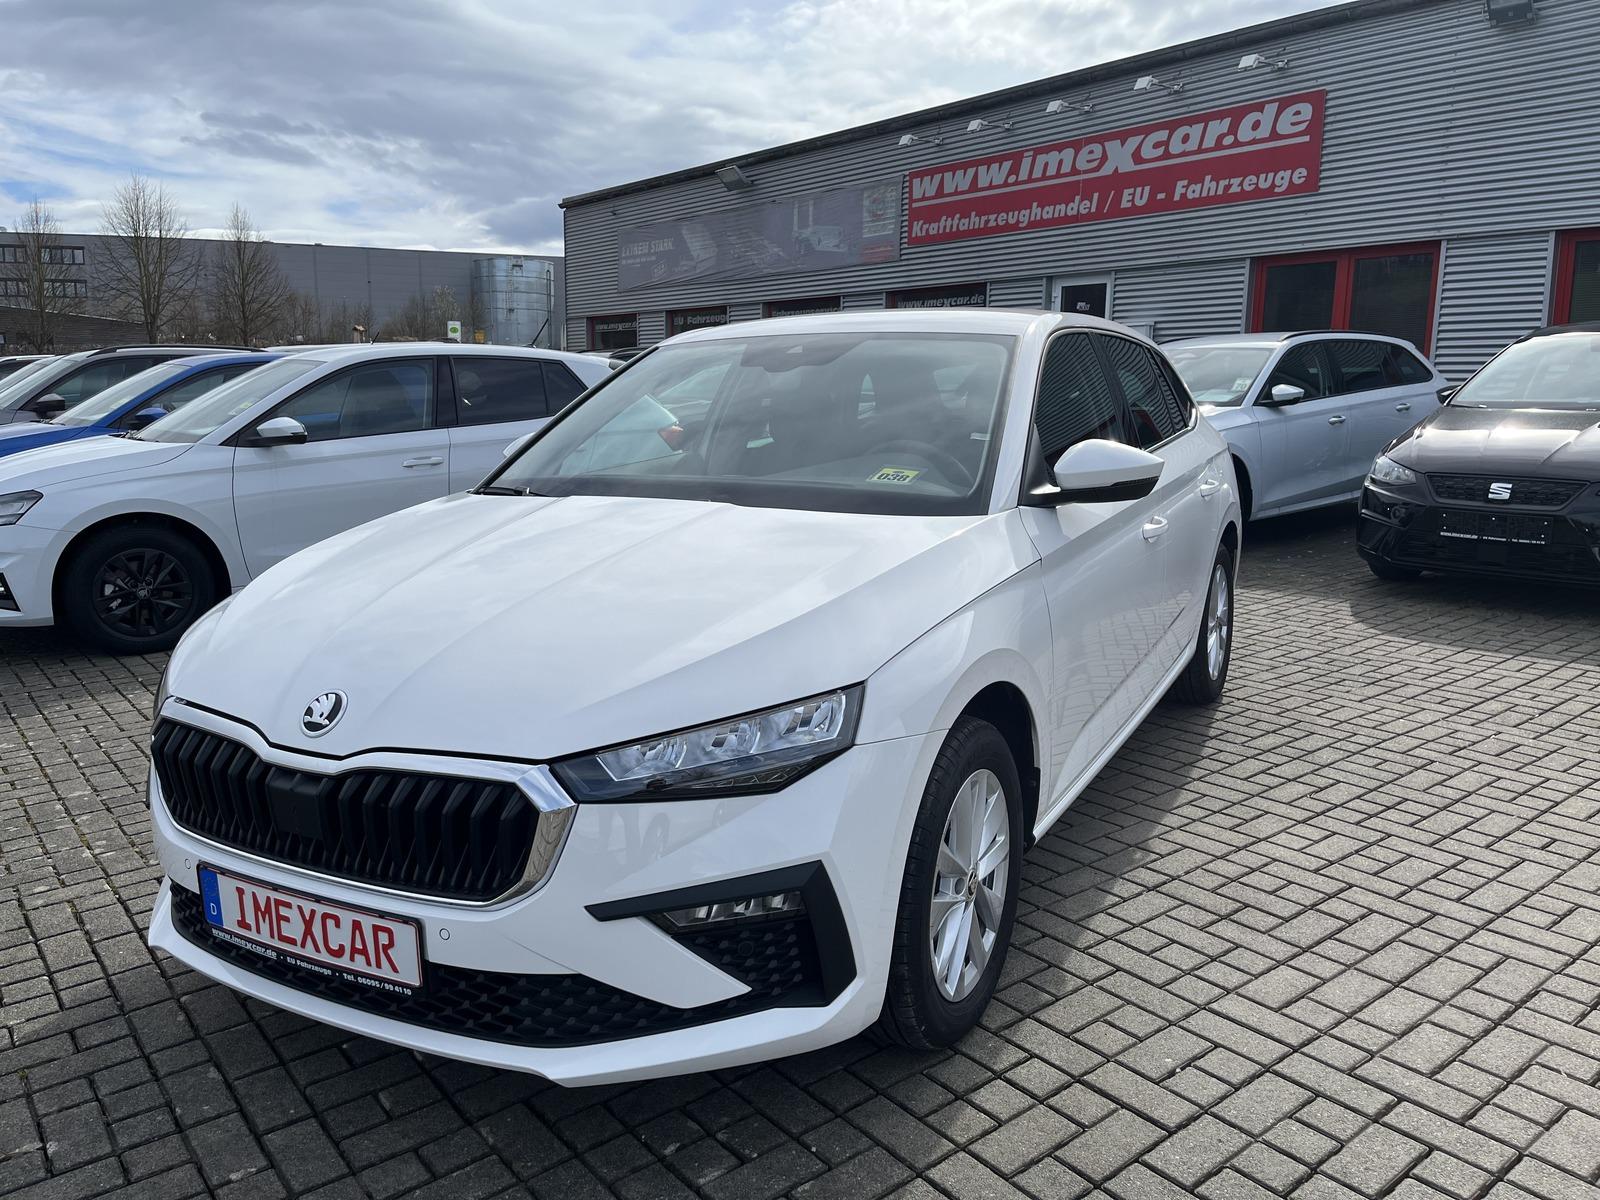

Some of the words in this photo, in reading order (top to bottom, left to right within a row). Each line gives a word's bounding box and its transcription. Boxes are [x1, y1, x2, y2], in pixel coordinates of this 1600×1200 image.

[912, 102, 1313, 199] www.imexcar.de
[911, 192, 1099, 238] Kraftfahrzeughandel
[1120, 185, 1150, 208] EU
[1173, 167, 1308, 202] Fahrzeuge
[877, 473, 910, 482] 038
[210, 902, 217, 915] D
[235, 886, 400, 974] IMEXCAR
[212, 928, 277, 958] www.imexcar.de
[296, 958, 332, 976] Fahrzeuge
